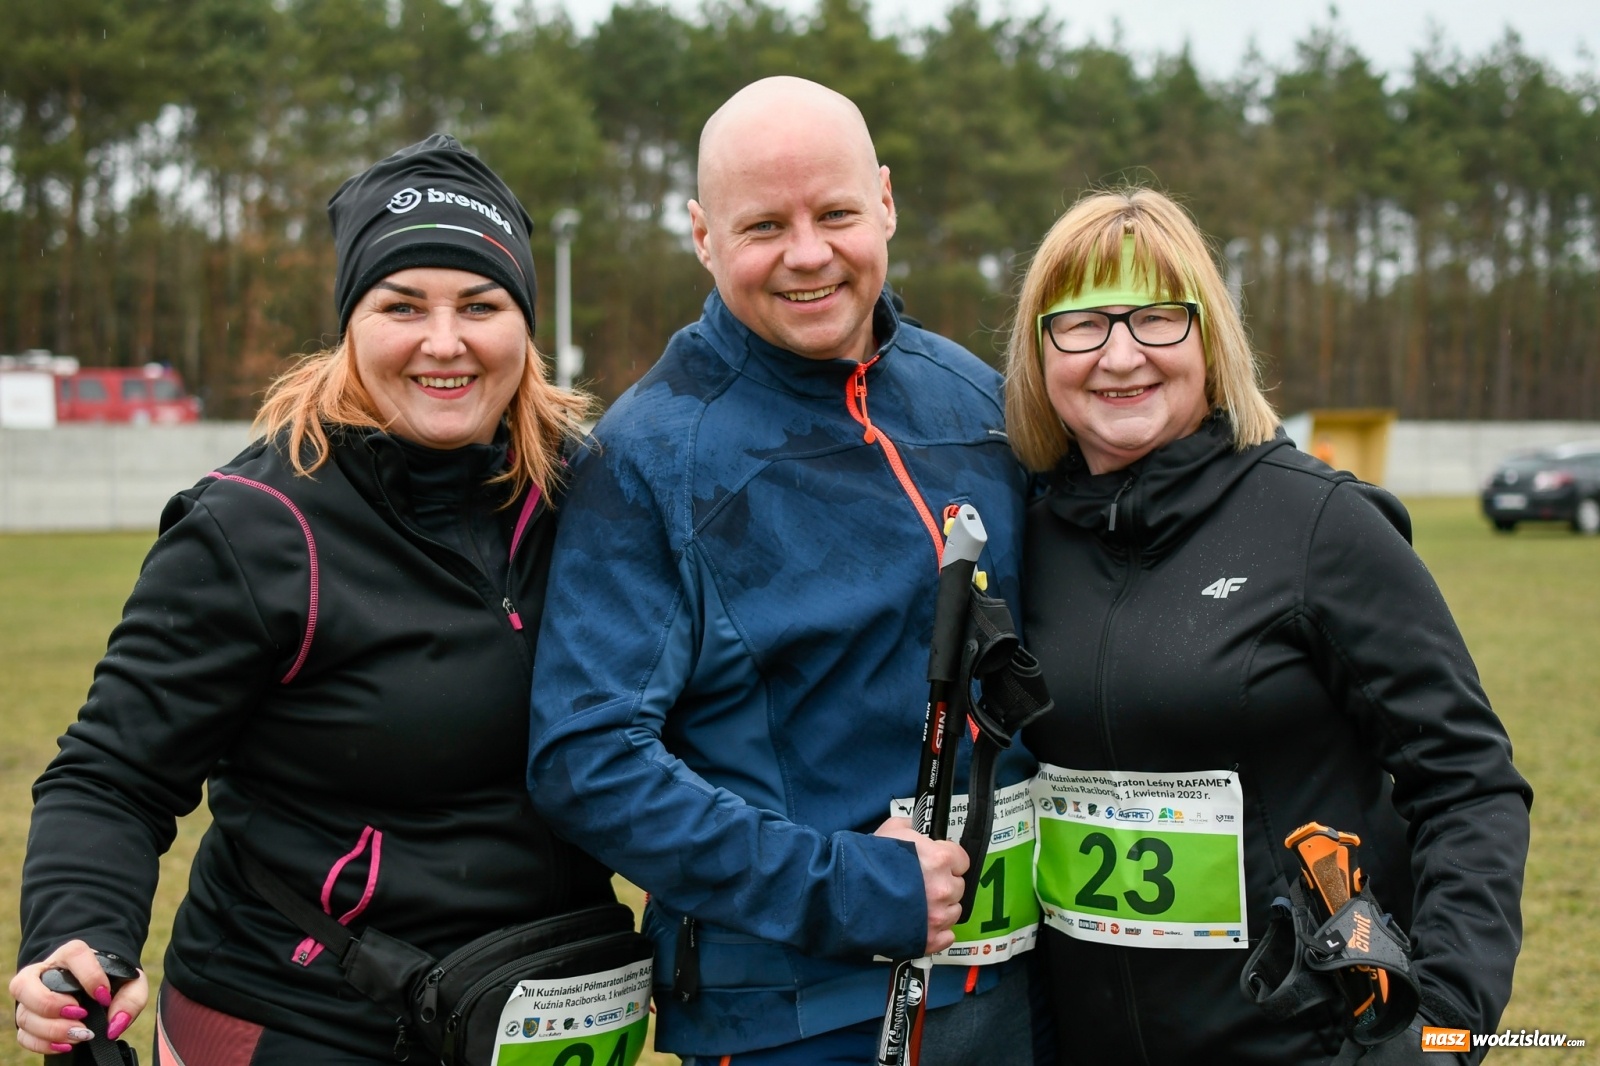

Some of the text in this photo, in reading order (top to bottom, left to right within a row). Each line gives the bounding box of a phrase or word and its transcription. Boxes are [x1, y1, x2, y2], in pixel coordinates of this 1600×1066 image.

[1201, 577, 1248, 599] 4F
[935, 711, 947, 749] NILS
[1048, 773, 1093, 785] Kuźniański
[1146, 778, 1175, 789] Leśny
[1177, 778, 1229, 788] RAFAMET
[1051, 784, 1080, 794] Kuźnia
[1124, 790, 1131, 799] 1
[1133, 789, 1175, 799] kwietnia
[1177, 790, 1202, 800] 2023
[993, 795, 1012, 807] araton
[921, 795, 936, 839] ESC
[1075, 832, 1176, 915] 23
[533, 1000, 564, 1010] Kuźnia
[565, 993, 607, 1008] Raciborska,
[613, 983, 637, 999] kwietnia
[536, 984, 583, 997] Kuźniański
[584, 976, 624, 992] Półmaraton
